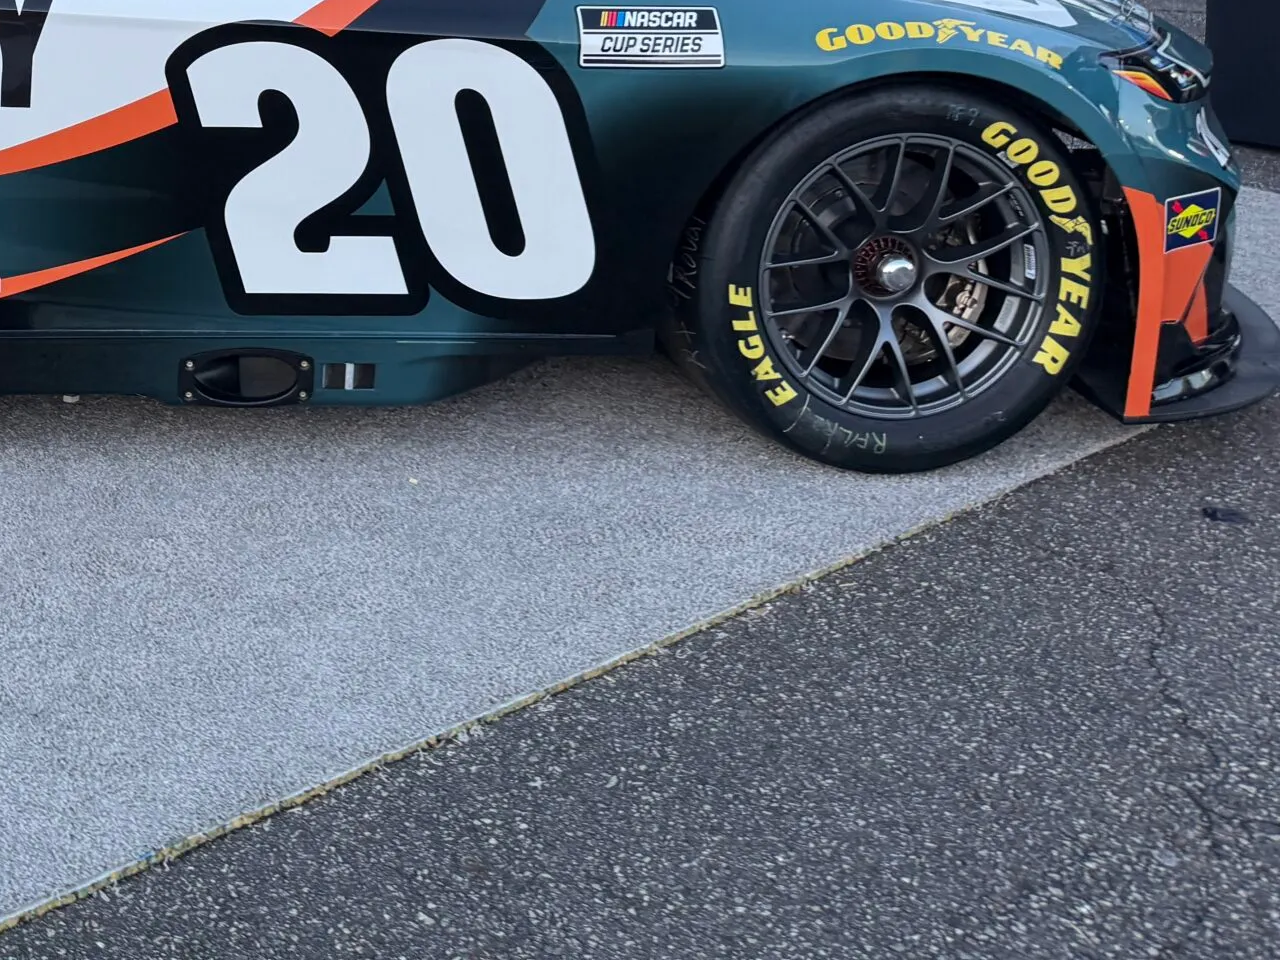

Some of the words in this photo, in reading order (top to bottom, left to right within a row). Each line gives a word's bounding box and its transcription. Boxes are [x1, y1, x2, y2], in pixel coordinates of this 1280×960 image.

[624, 10, 698, 28] NASCAR
[600, 36, 637, 53] CUP
[639, 36, 703, 53] SERIES
[185, 38, 596, 300] 20
[1168, 209, 1216, 232] SUNOCO
[728, 283, 798, 407] EAGLE
